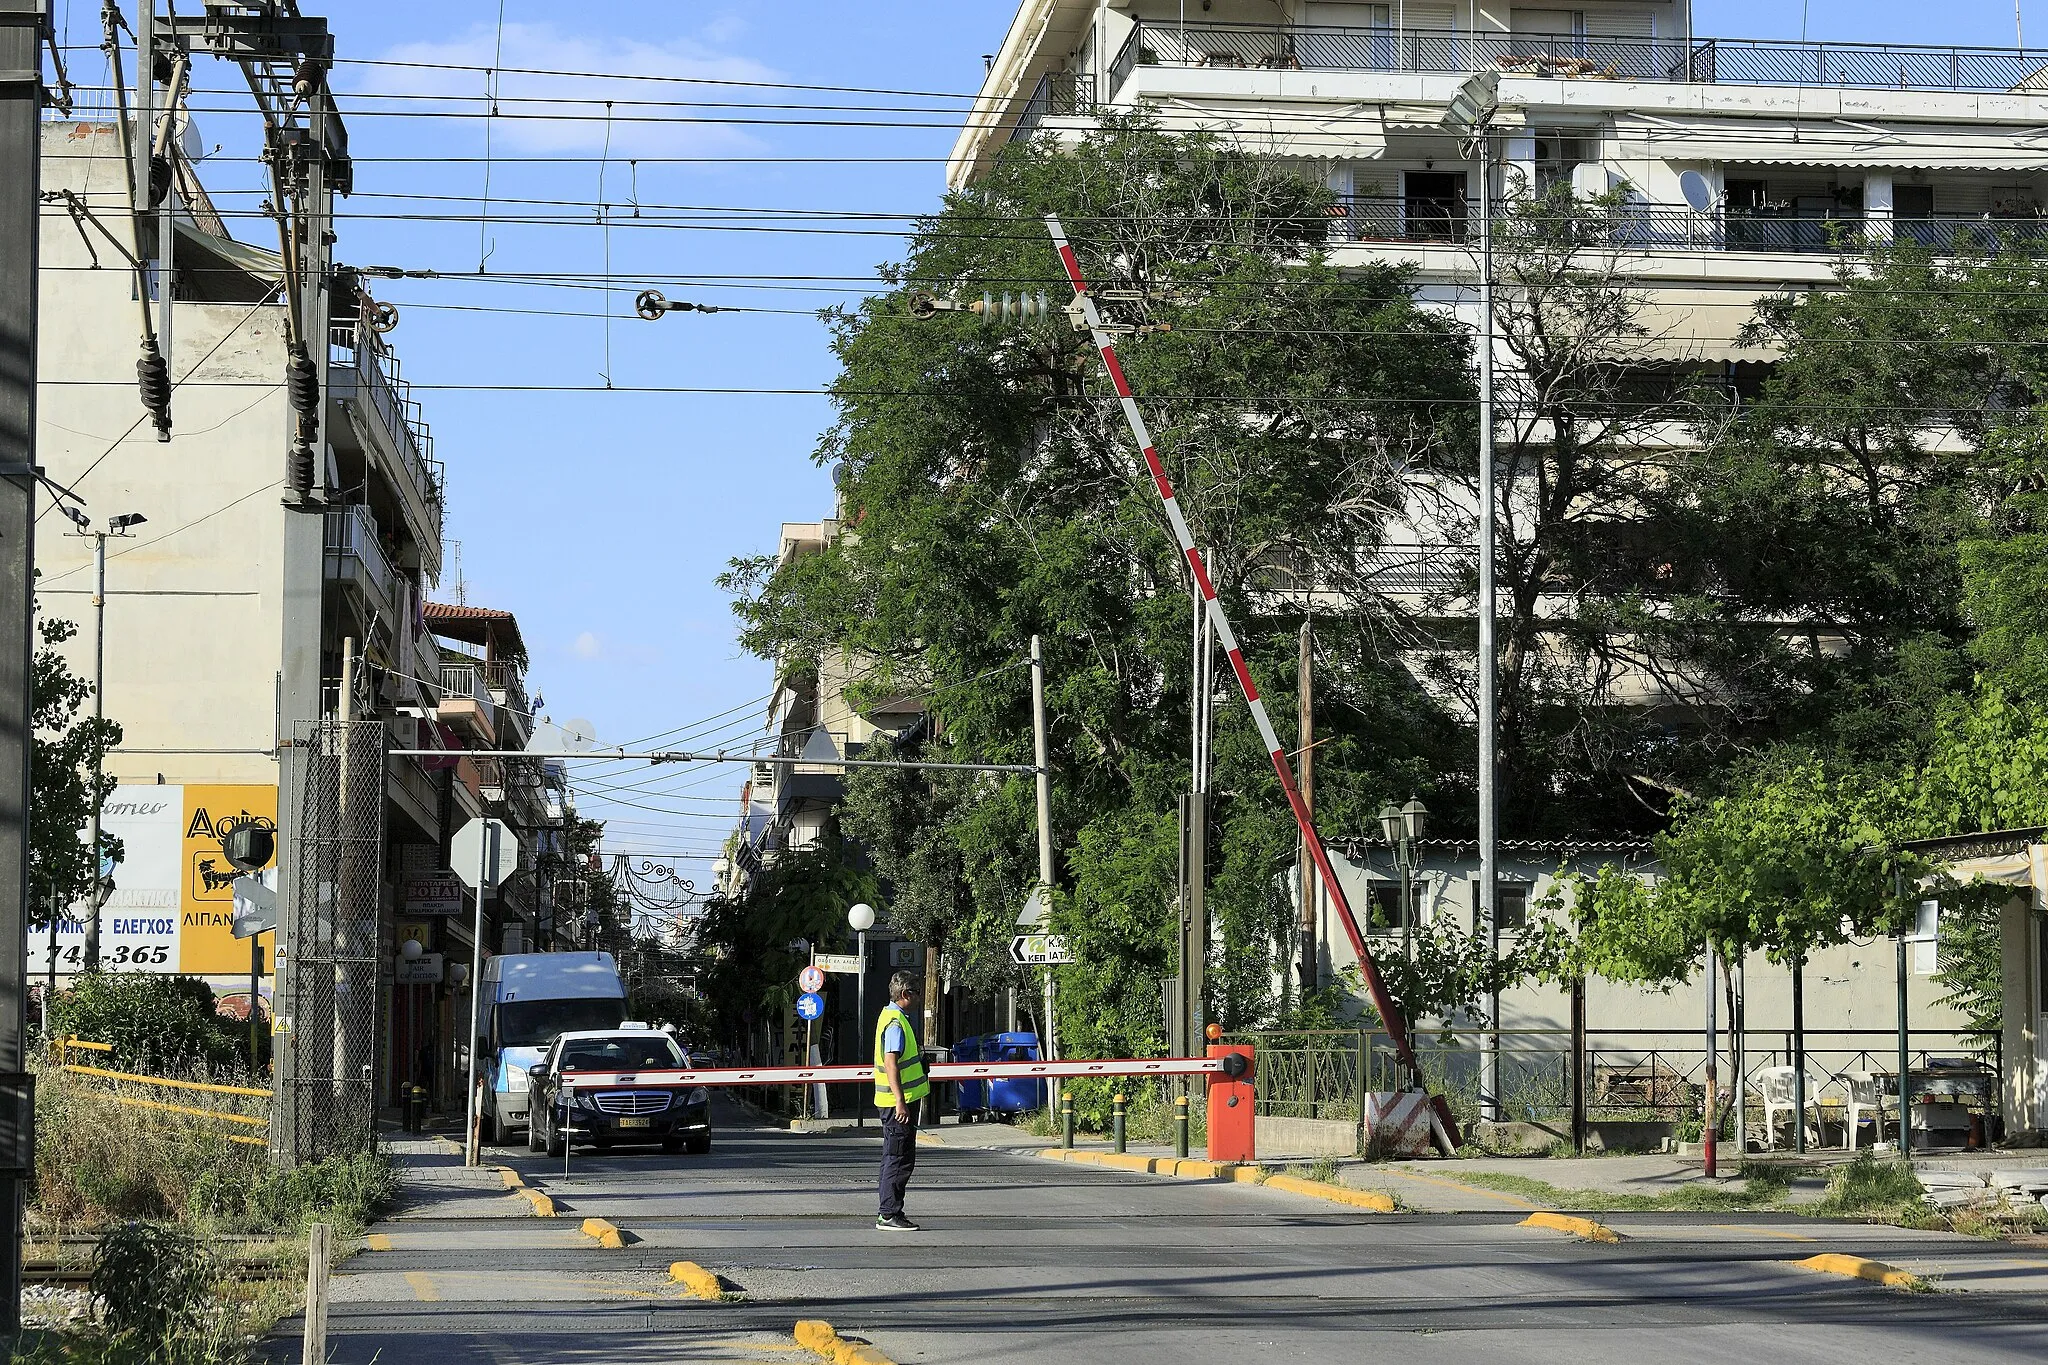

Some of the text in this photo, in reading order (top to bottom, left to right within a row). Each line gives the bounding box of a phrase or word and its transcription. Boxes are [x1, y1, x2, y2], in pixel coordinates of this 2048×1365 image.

[102, 802, 168, 815] omeo
[186, 808, 276, 847] Ag
[113, 918, 174, 934] ΕΛΕΓΧΟΣ
[183, 912, 233, 926] ΛΙΠΑΝ
[46, 945, 170, 964] 74-365
[1028, 954, 1046, 962] ΚΕΠ
[1049, 951, 1076, 960] ΙΑΤΡΕ
